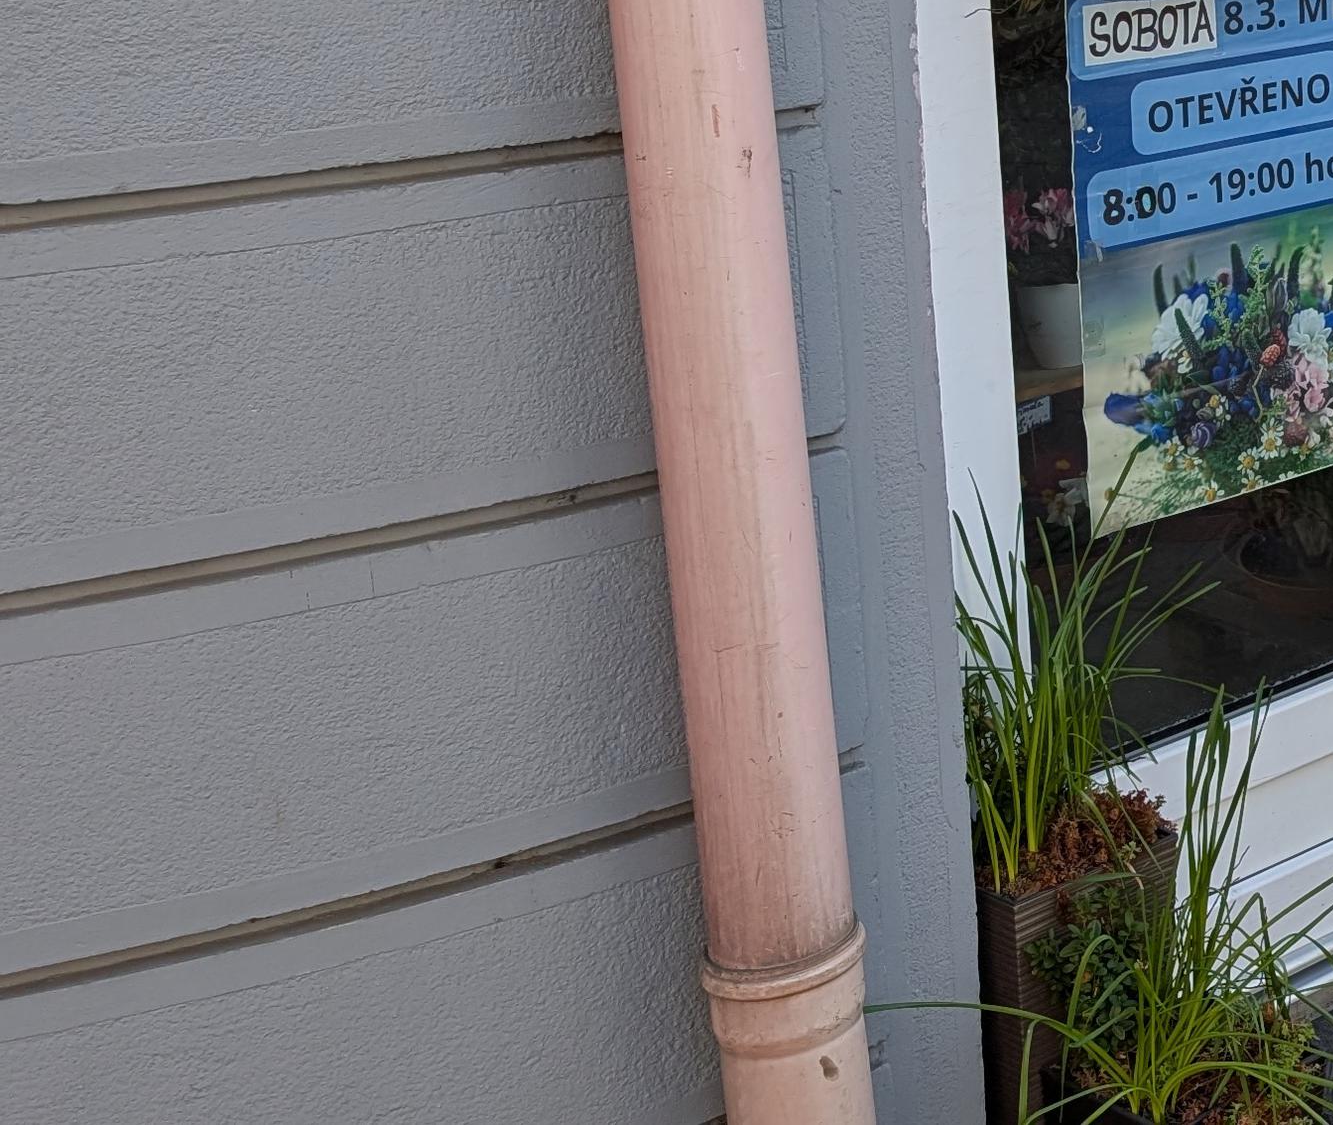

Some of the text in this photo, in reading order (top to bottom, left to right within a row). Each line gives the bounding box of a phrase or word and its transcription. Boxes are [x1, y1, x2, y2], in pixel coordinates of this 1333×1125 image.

[1089, 0, 1215, 58] SOBOTA
[1147, 73, 1331, 134] OTEVŘENO
[1102, 181, 1178, 227] 8:00
[1208, 157, 1295, 204] 19:00
